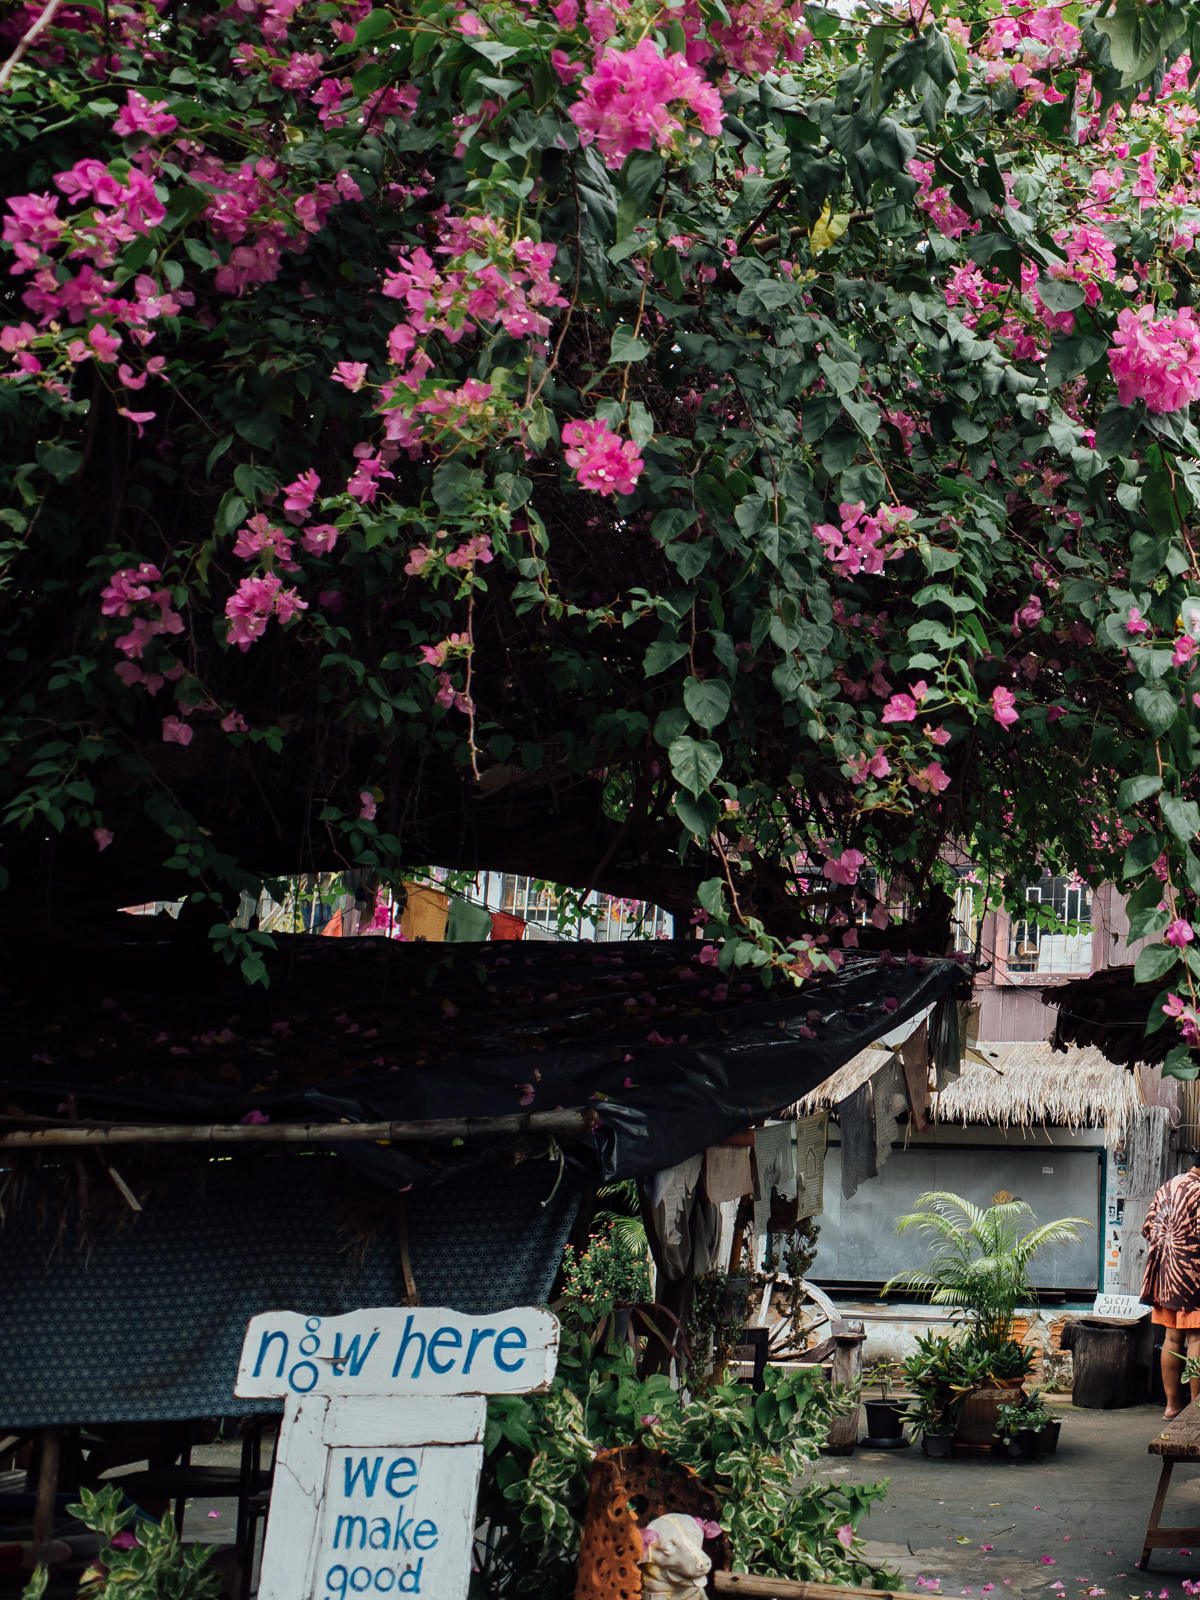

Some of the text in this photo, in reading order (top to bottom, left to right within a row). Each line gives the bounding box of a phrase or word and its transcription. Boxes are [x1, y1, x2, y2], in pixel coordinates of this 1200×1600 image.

[252, 1315, 527, 1393] now here
[344, 1456, 418, 1499] we
[333, 1505, 439, 1550] make
[325, 1557, 424, 1600] good
